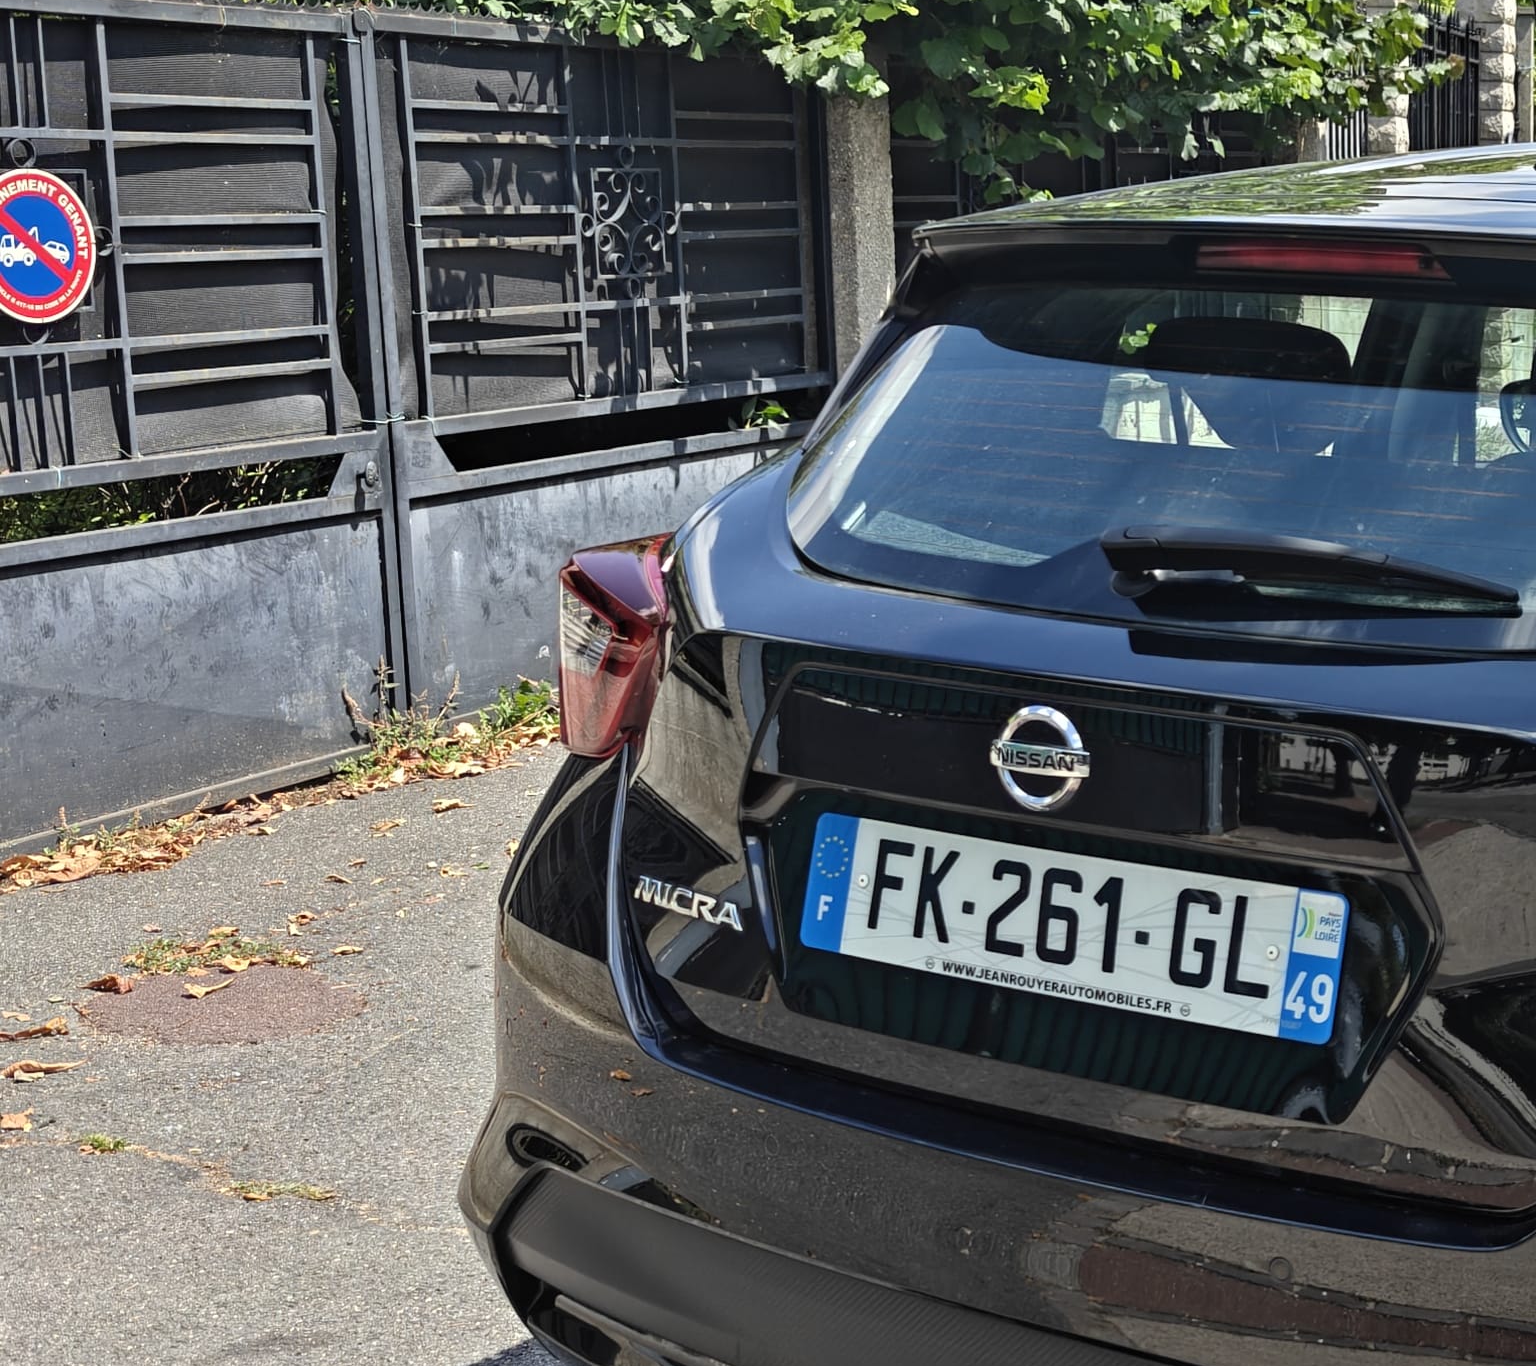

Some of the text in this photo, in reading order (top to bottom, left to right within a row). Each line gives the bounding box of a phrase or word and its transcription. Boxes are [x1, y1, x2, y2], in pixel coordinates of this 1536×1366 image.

[0, 179, 88, 259] NEMENT GENANT
[997, 746, 1075, 772] NISSAN
[633, 875, 743, 932] MICRA
[816, 894, 834, 922] F
[866, 838, 1270, 1000] FK-261-GL
[941, 960, 1172, 1014] WWW.JEANROUYERAUTOMOBILES.FR
[1284, 971, 1334, 1024] 49
